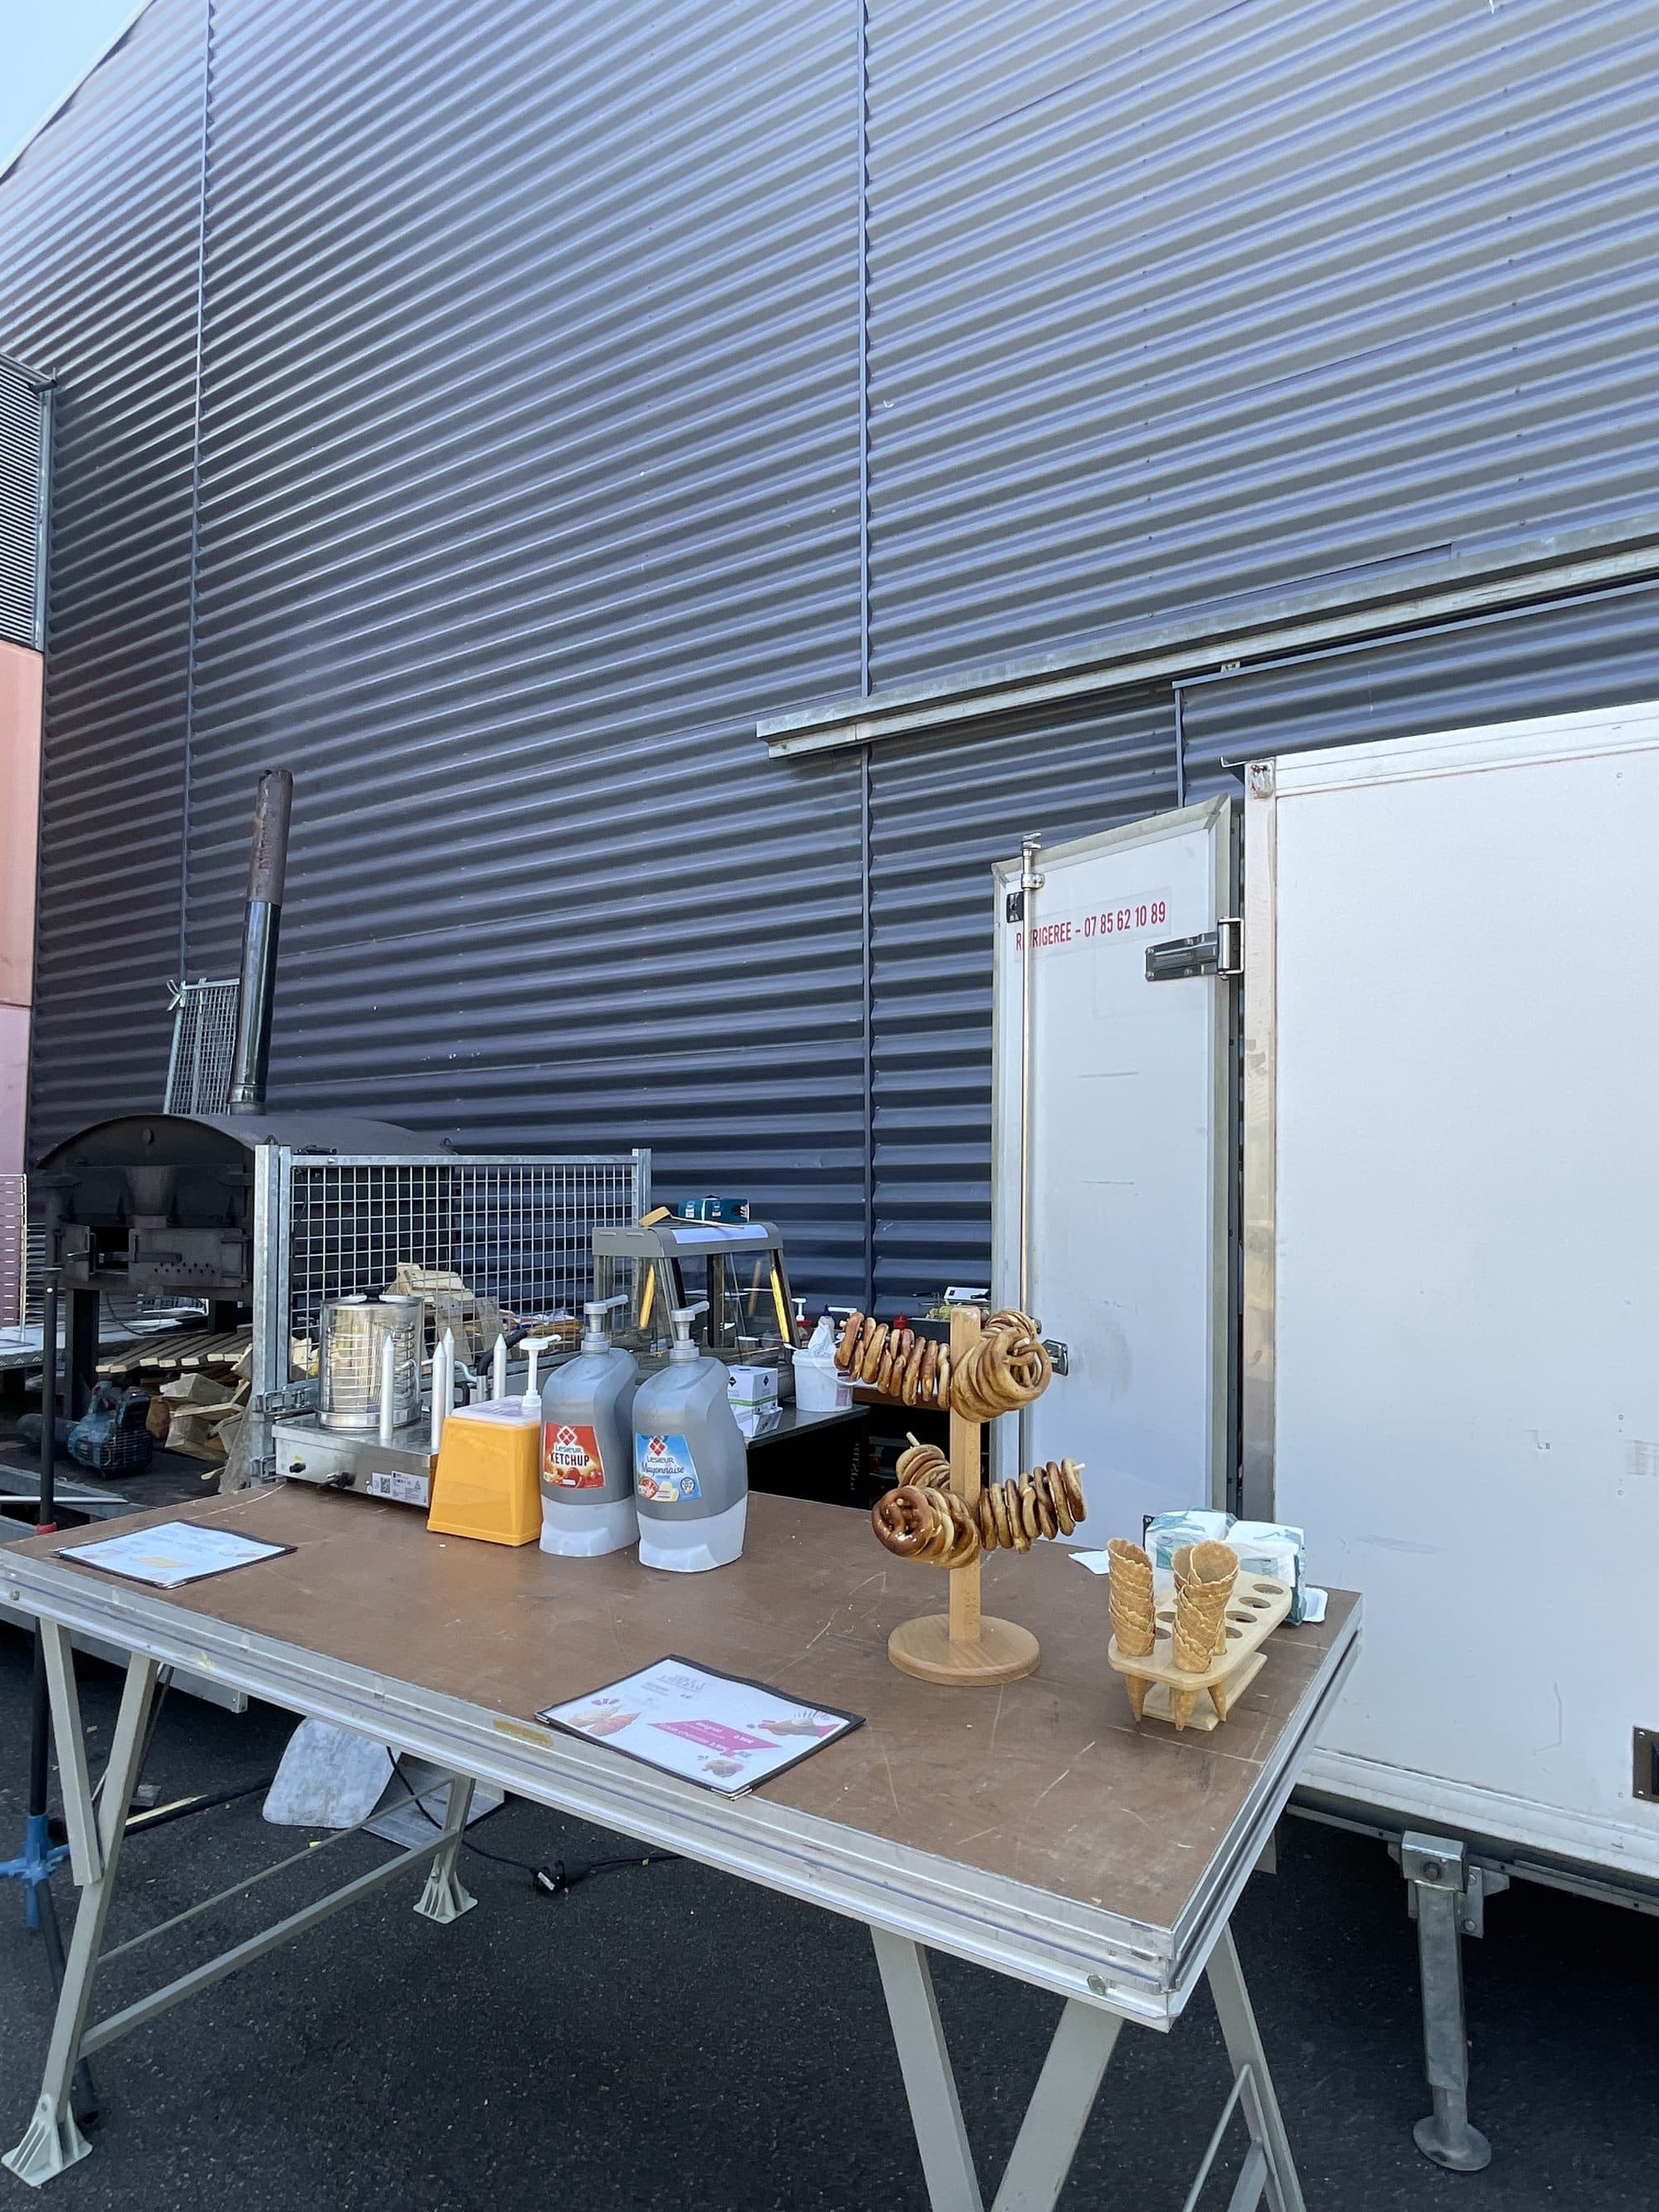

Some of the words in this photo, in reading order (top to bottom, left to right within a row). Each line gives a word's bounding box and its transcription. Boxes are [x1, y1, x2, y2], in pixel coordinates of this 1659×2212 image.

[1015, 922, 1072, 952] RRIGEREE
[1084, 916, 1097, 938] 07
[1100, 913, 1113, 935] 85
[1117, 909, 1131, 931] 62
[1135, 905, 1146, 928] 10
[1151, 901, 1165, 924] 89
[550, 1452, 590, 1467] KETCHUP
[641, 1460, 685, 1477] Mayonnaise
